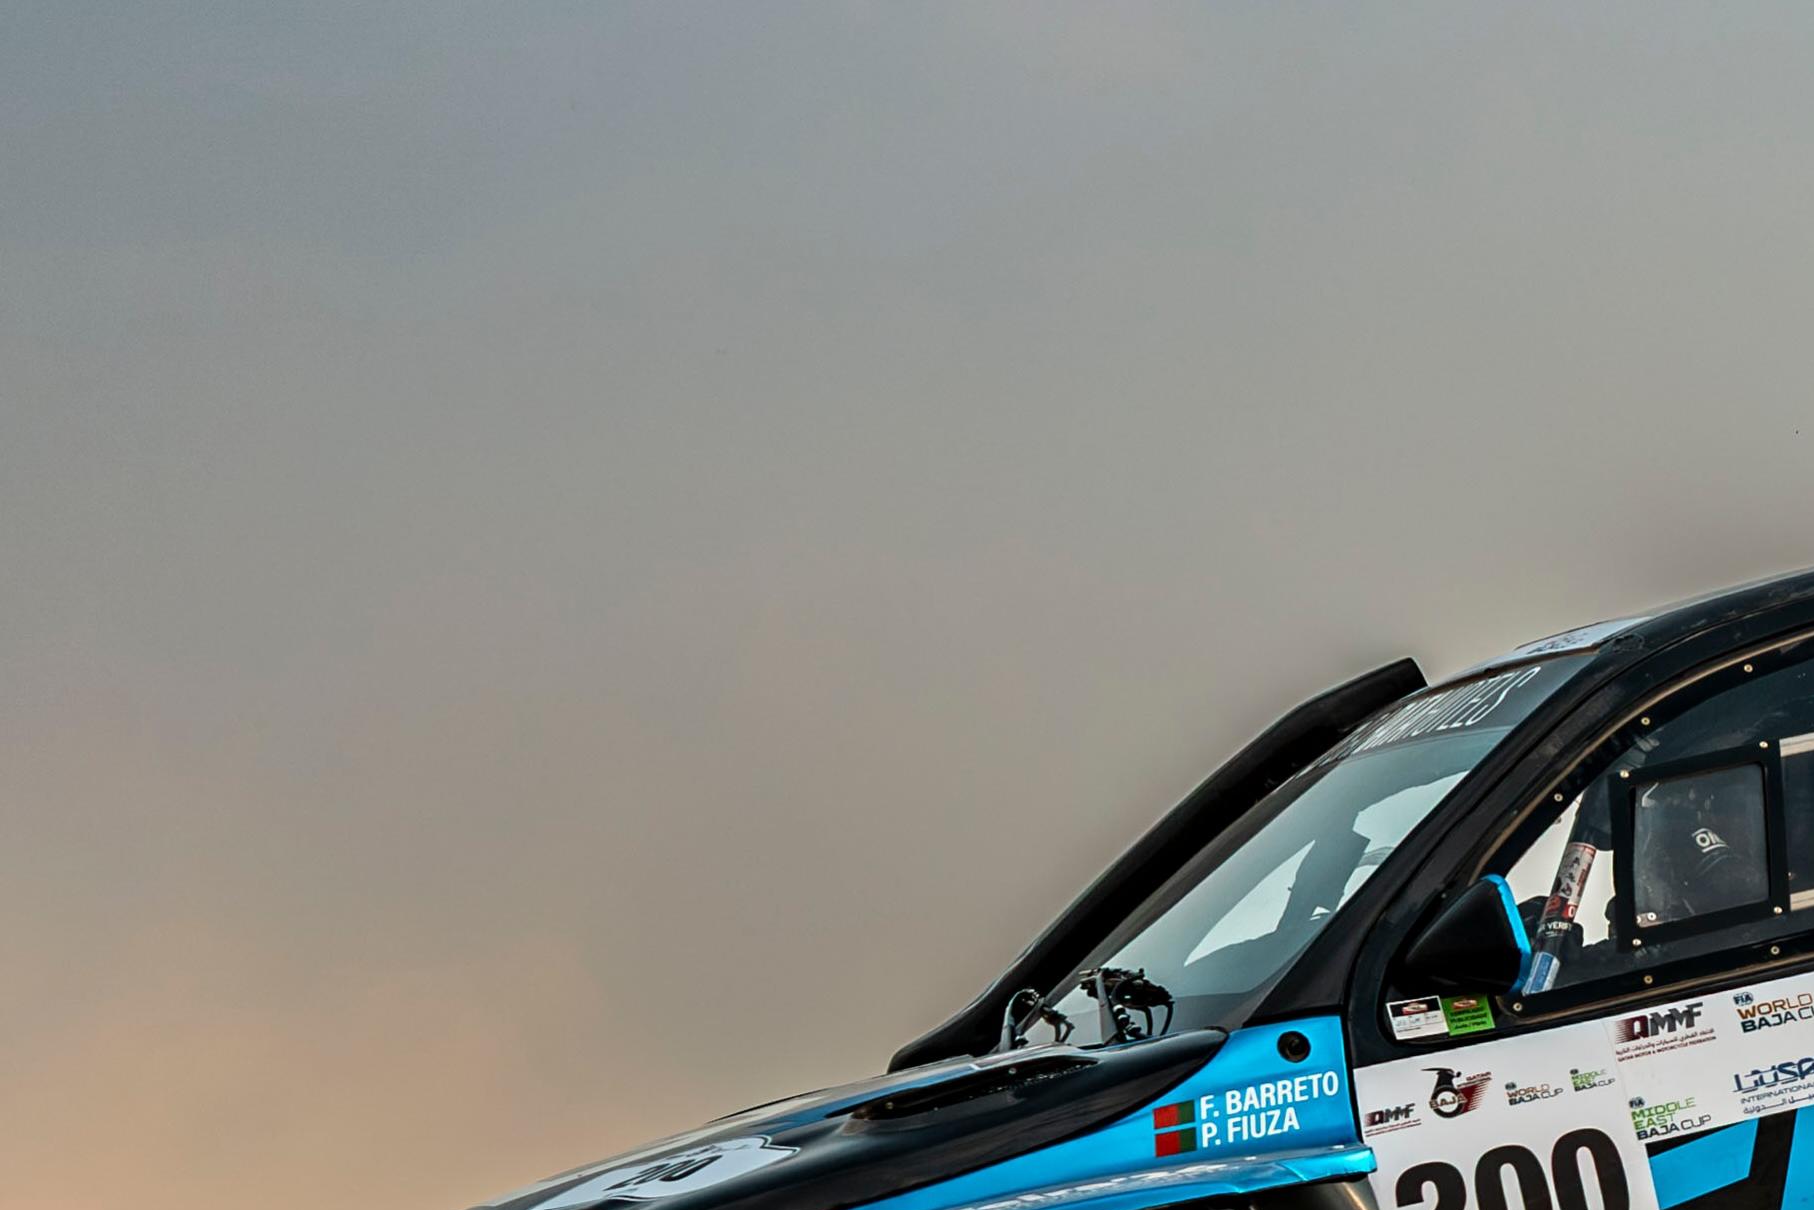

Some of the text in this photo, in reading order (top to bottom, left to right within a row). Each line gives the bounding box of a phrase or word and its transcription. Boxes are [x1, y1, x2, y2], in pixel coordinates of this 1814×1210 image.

[1736, 993, 1813, 1020] WORLD
[1740, 1008, 1797, 1034] BAJA
[1200, 1071, 1340, 1120] F. BARRETO
[1506, 1083, 1550, 1099] WORLD
[1508, 1087, 1564, 1106] BAJA CUP
[1631, 1097, 1696, 1121] MIDDLE
[1634, 1112, 1675, 1131] EAST
[1202, 1107, 1300, 1148] P. FIUZA
[1637, 1114, 1712, 1141] BAJA CUP
